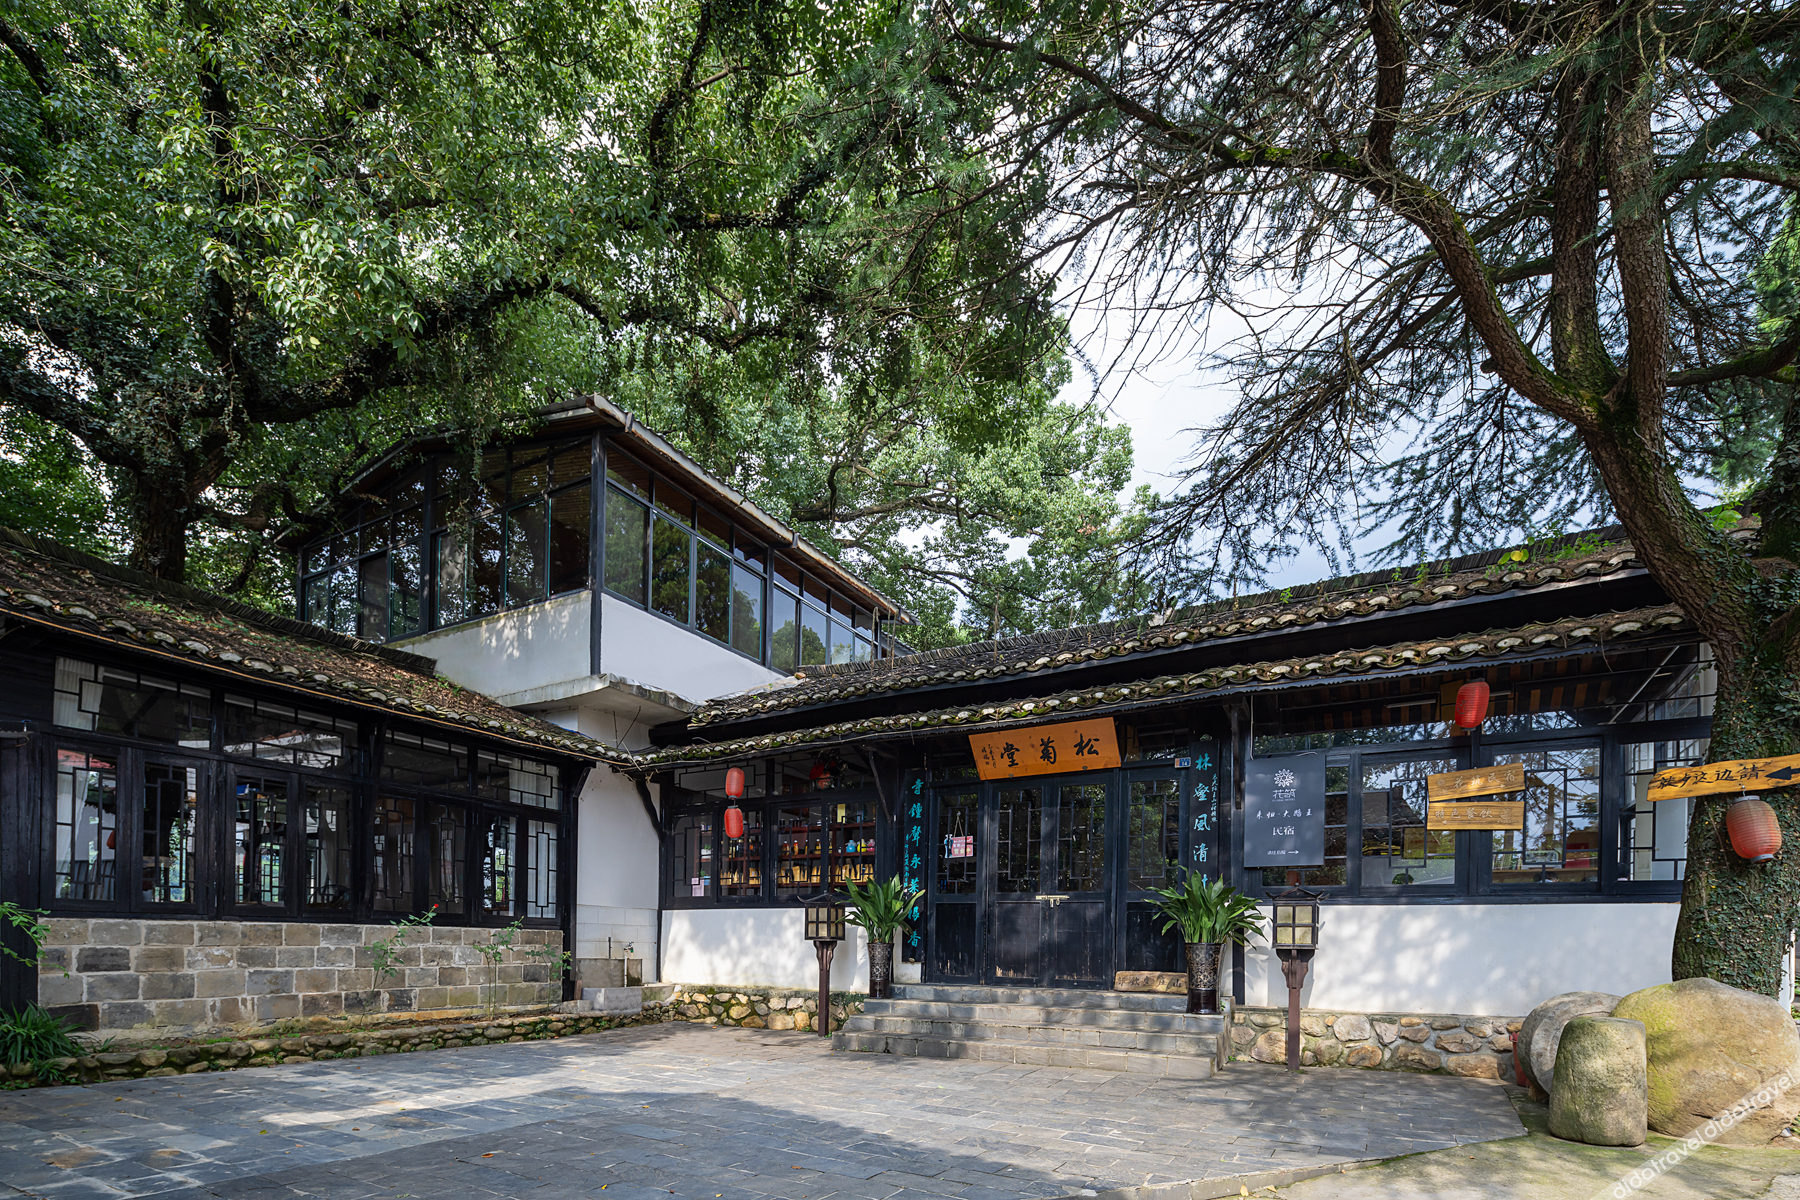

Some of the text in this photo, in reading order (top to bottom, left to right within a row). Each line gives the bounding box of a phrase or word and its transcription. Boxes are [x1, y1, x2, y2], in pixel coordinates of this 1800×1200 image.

[1000, 733, 1100, 767] 松菊堂
[1272, 825, 1295, 836] 民宿
